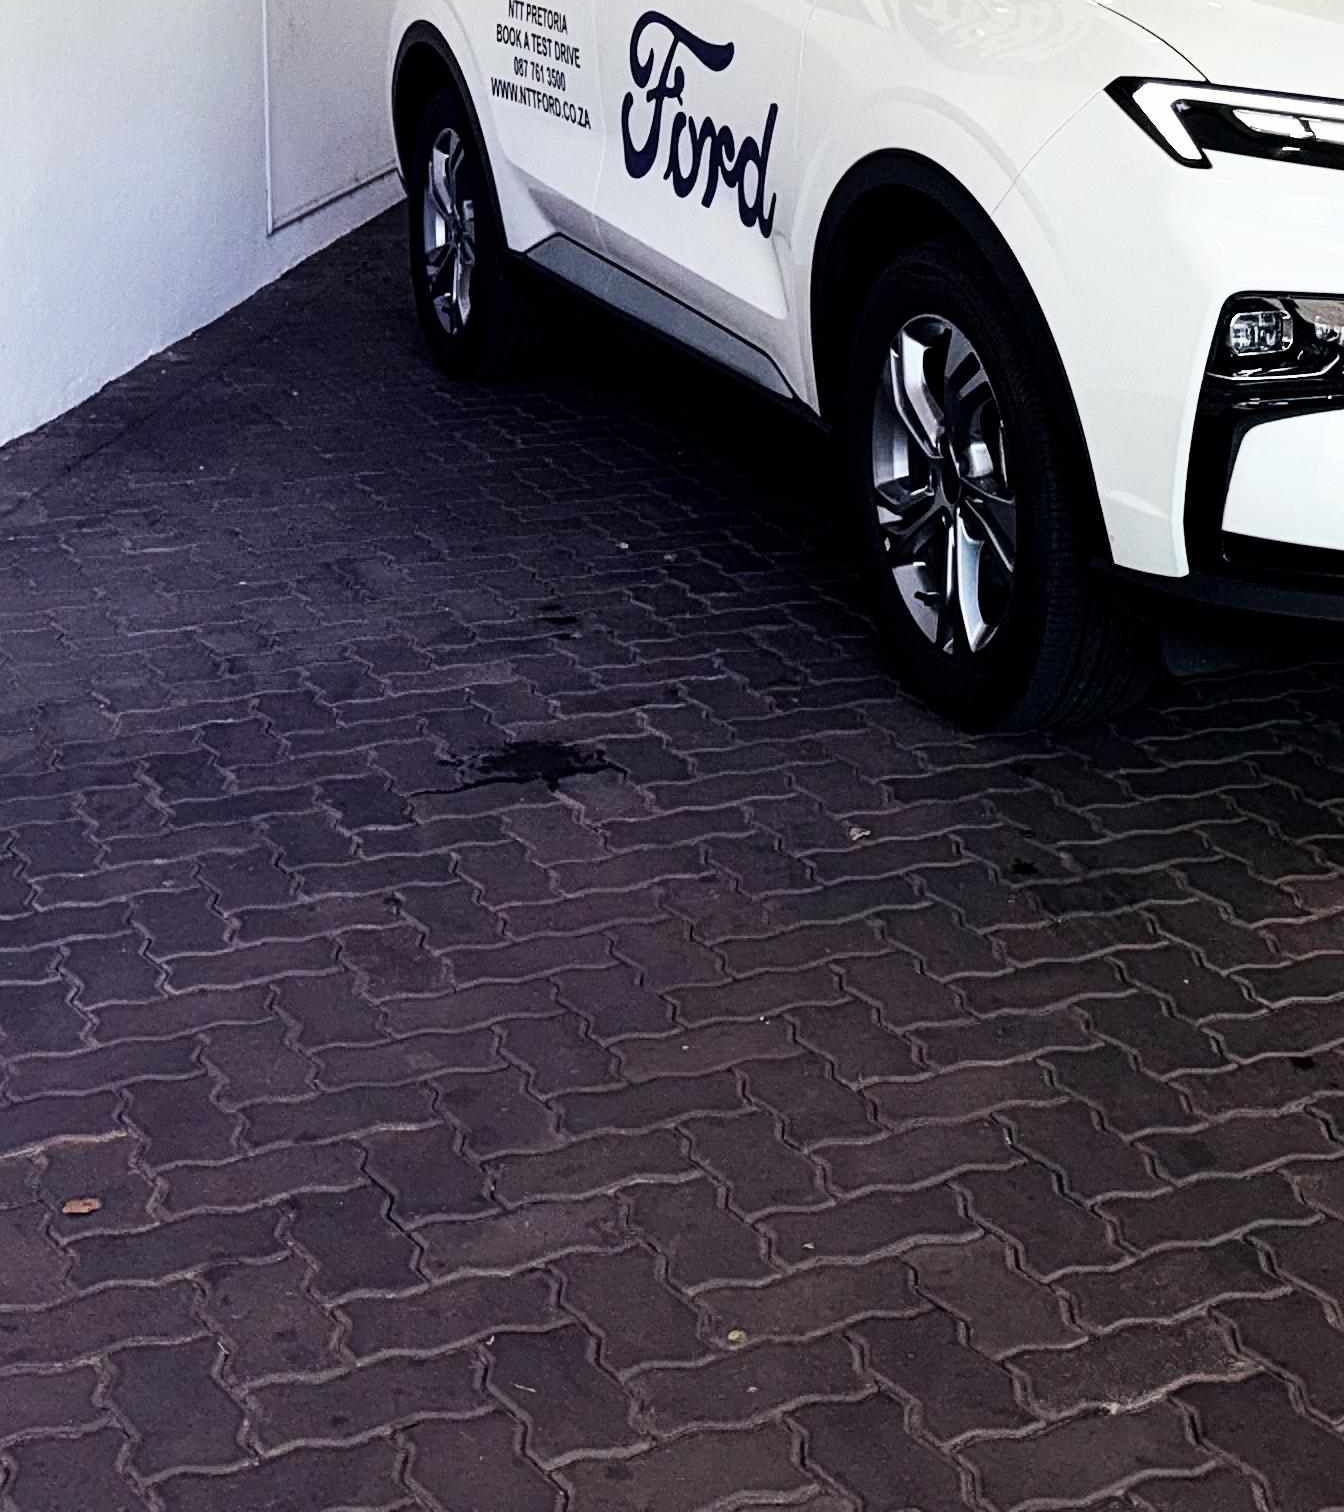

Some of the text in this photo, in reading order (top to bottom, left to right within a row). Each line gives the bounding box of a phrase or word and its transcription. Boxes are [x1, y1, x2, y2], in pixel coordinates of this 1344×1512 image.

[526, 3, 568, 34] PRETORIA
[496, 24, 581, 69] BOOK A TEST DRIVE
[513, 56, 566, 92] 087 761 3500
[490, 77, 592, 130] WWW.NTTFORD.CO.ZA
[622, 11, 778, 239] Ford
